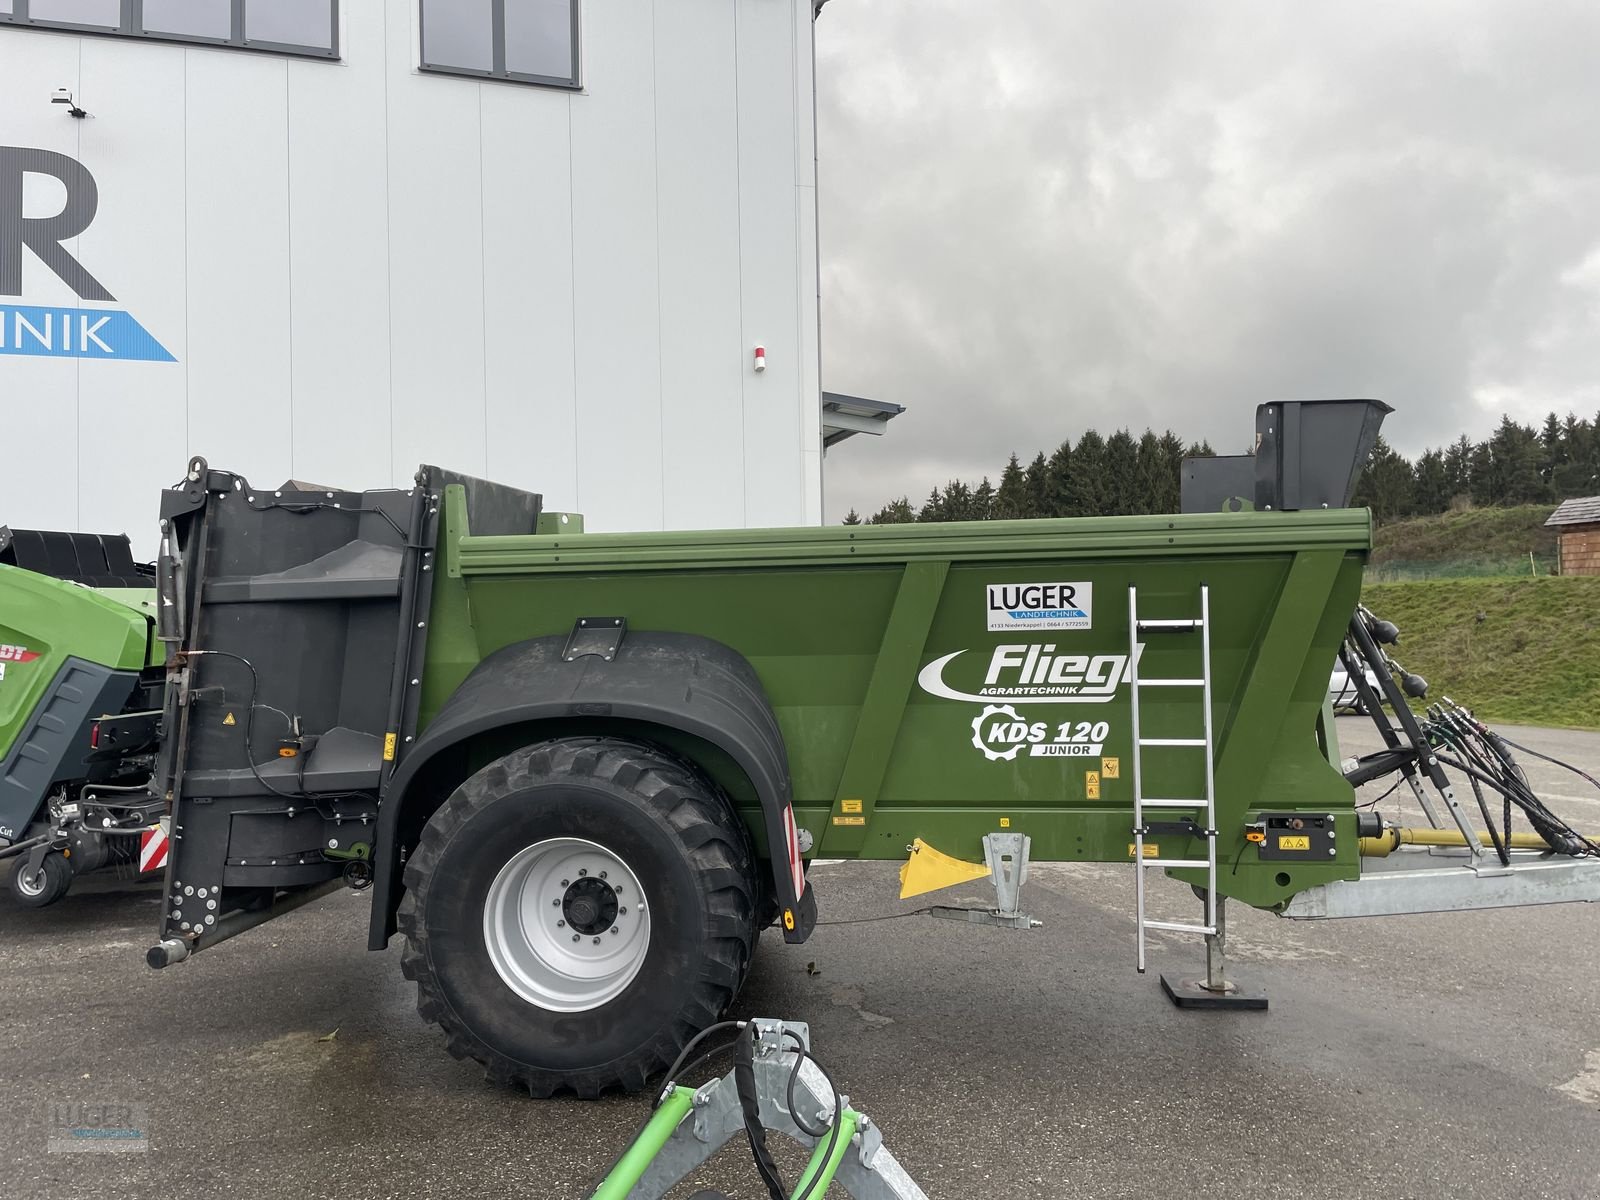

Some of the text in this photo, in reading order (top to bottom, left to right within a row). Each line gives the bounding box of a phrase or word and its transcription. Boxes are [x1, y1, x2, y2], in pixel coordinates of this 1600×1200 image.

[990, 585, 1078, 610] LUGER
[1015, 610, 1079, 618] LANDTECHNIK
[979, 686, 1079, 695] AGRARTECHNIK
[987, 721, 1110, 743] KDS 120
[1042, 745, 1091, 755] JUNIOR
